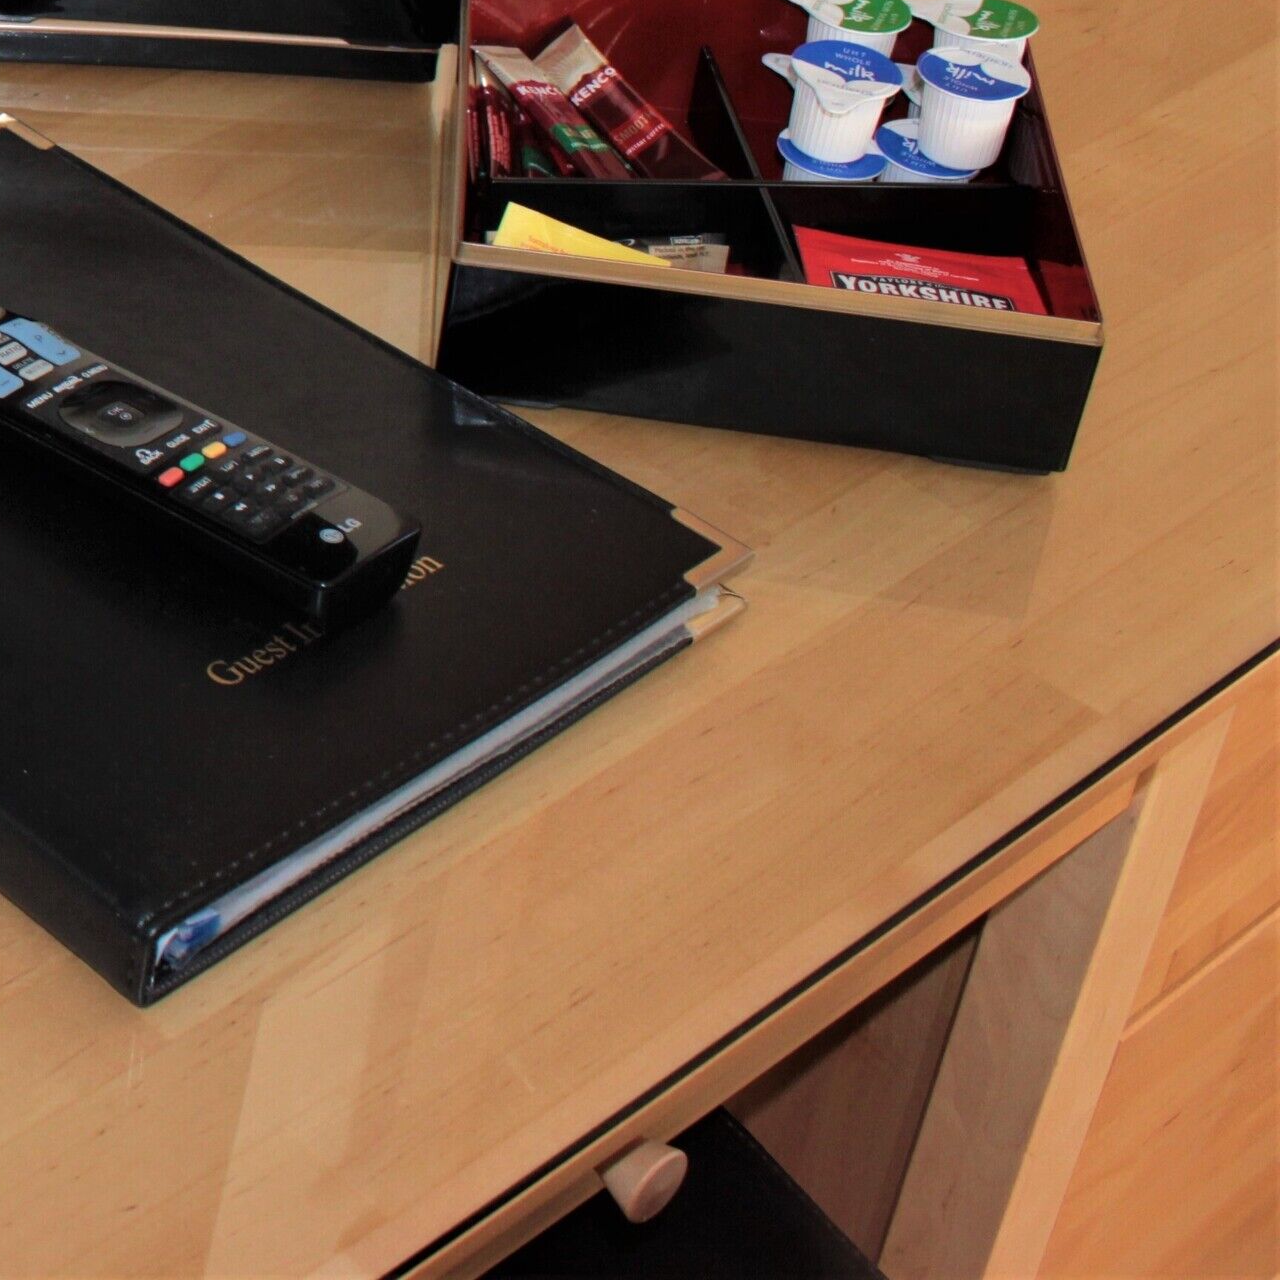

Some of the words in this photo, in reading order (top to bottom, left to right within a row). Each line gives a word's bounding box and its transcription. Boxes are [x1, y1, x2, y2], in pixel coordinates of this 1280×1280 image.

[824, 61, 876, 81] milk
[945, 62, 995, 85] milk
[516, 84, 561, 97] KENC
[570, 66, 616, 106] KENCO
[837, 274, 1009, 310] YORKSHIRE
[27, 392, 53, 408] MENU
[336, 517, 362, 533] LG
[206, 635, 297, 686] Guest
